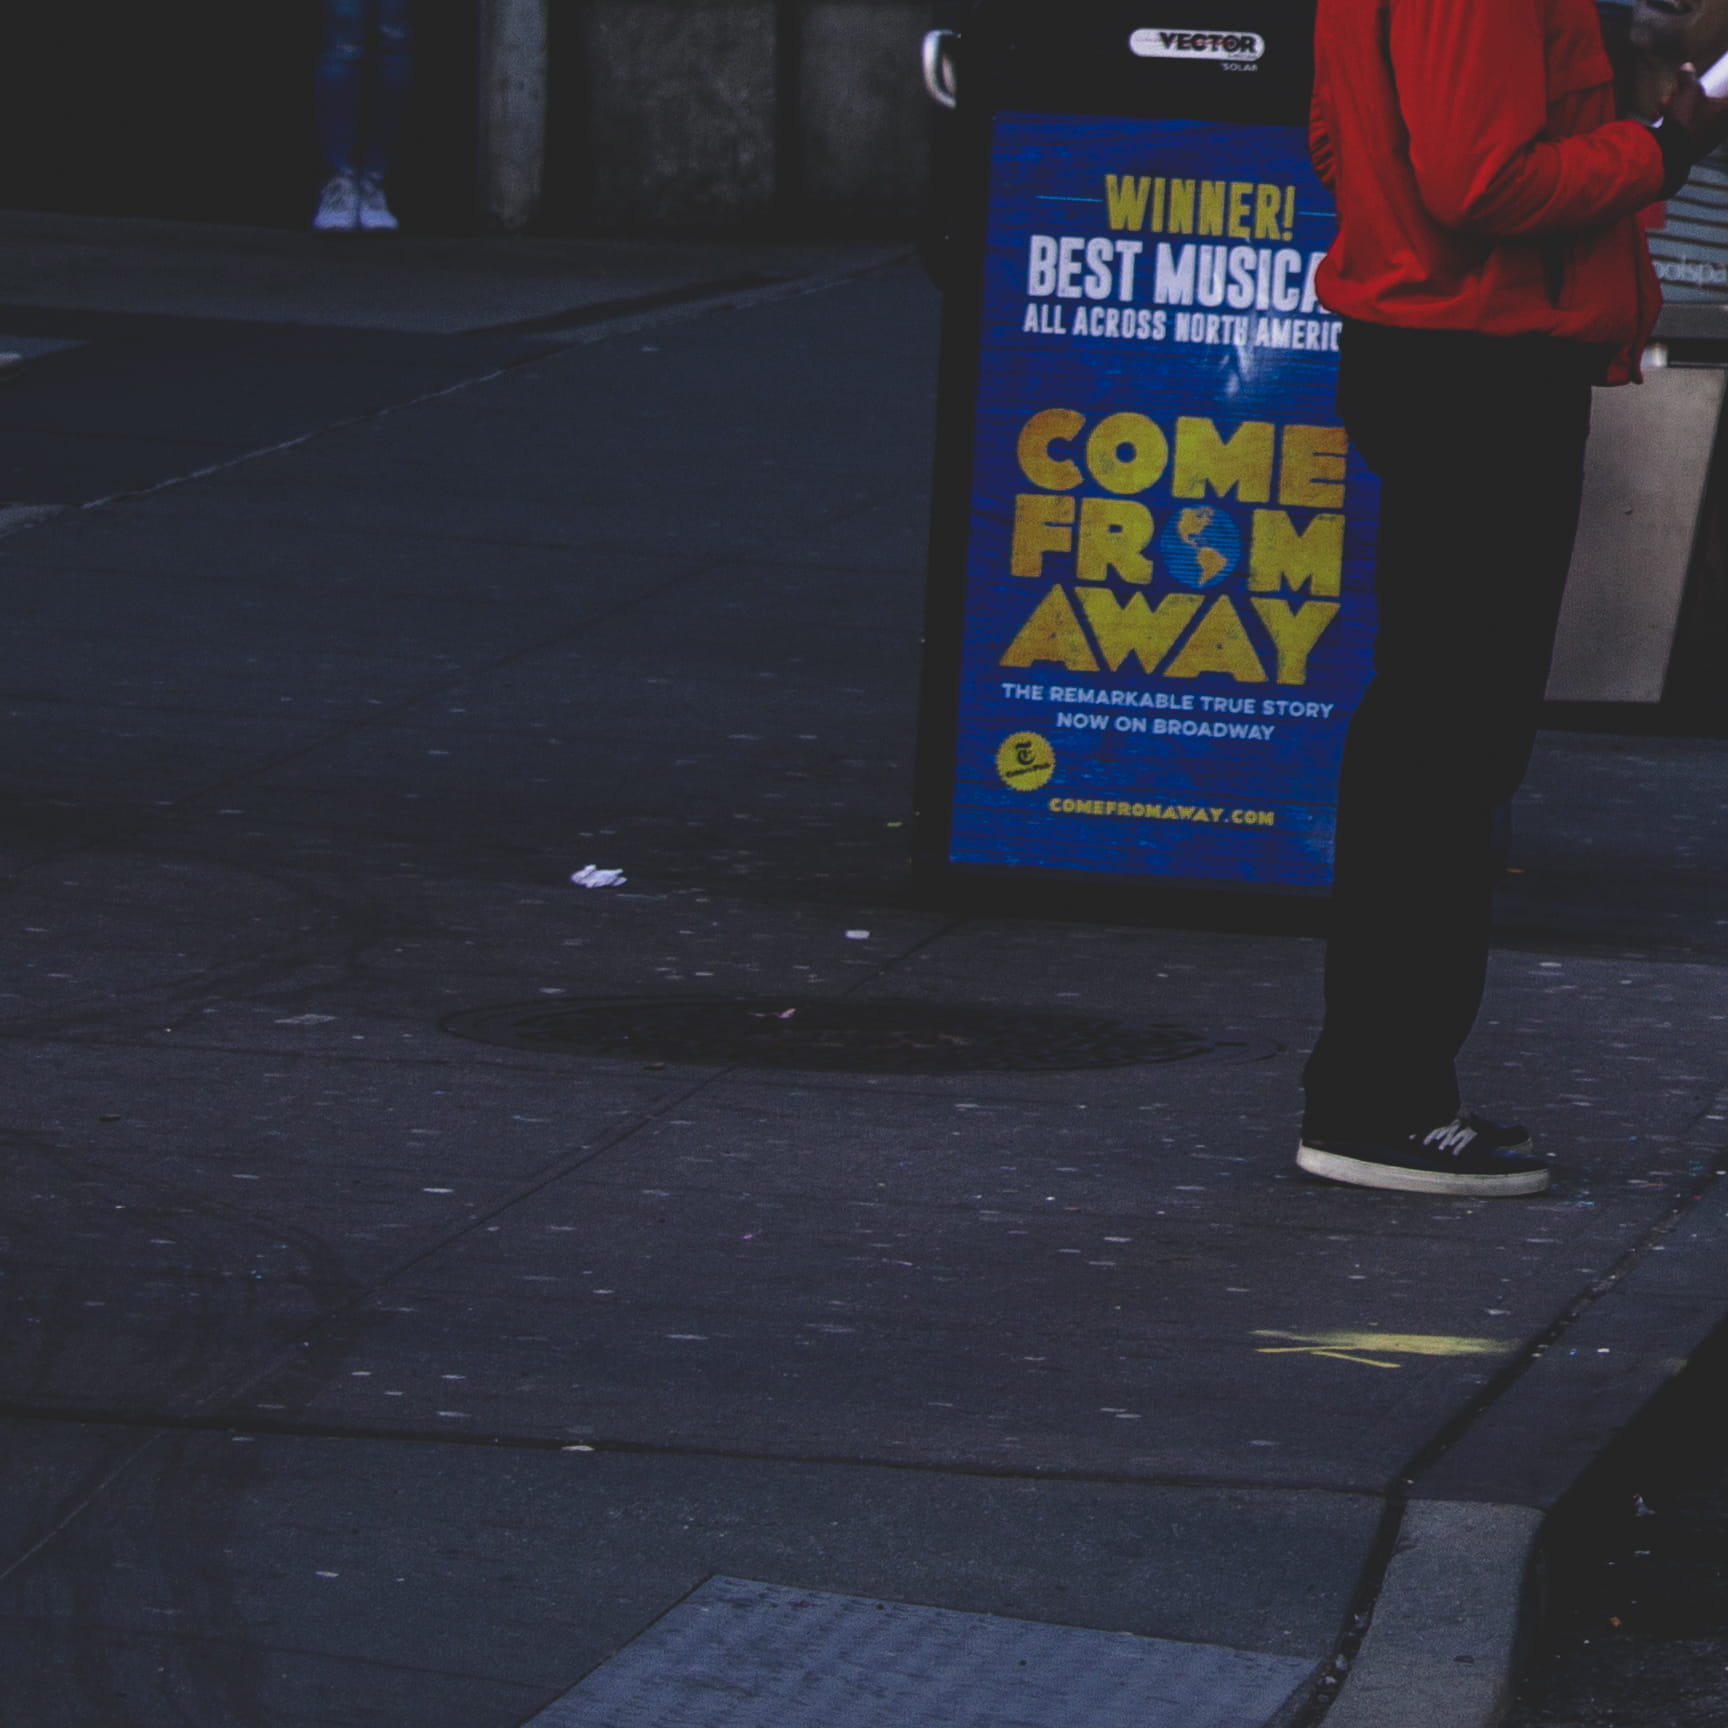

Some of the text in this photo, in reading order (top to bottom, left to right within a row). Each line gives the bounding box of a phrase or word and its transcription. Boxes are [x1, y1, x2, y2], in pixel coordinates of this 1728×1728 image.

[1159, 31, 1257, 54] VECTOR
[1105, 174, 1296, 242] WINNER!
[1027, 234, 1332, 315] BEST MUSICA
[1023, 303, 1343, 352] ALL ACROSS NORTH AMERIC
[1016, 407, 1349, 509] COME
[998, 583, 1342, 686] AWAY
[1001, 682, 1335, 719] THE REMARKABLE TRUE STORY
[1056, 711, 1276, 741] NOW ON BROADWAY
[1048, 797, 1275, 826] COMEFROMAWAY.COM
